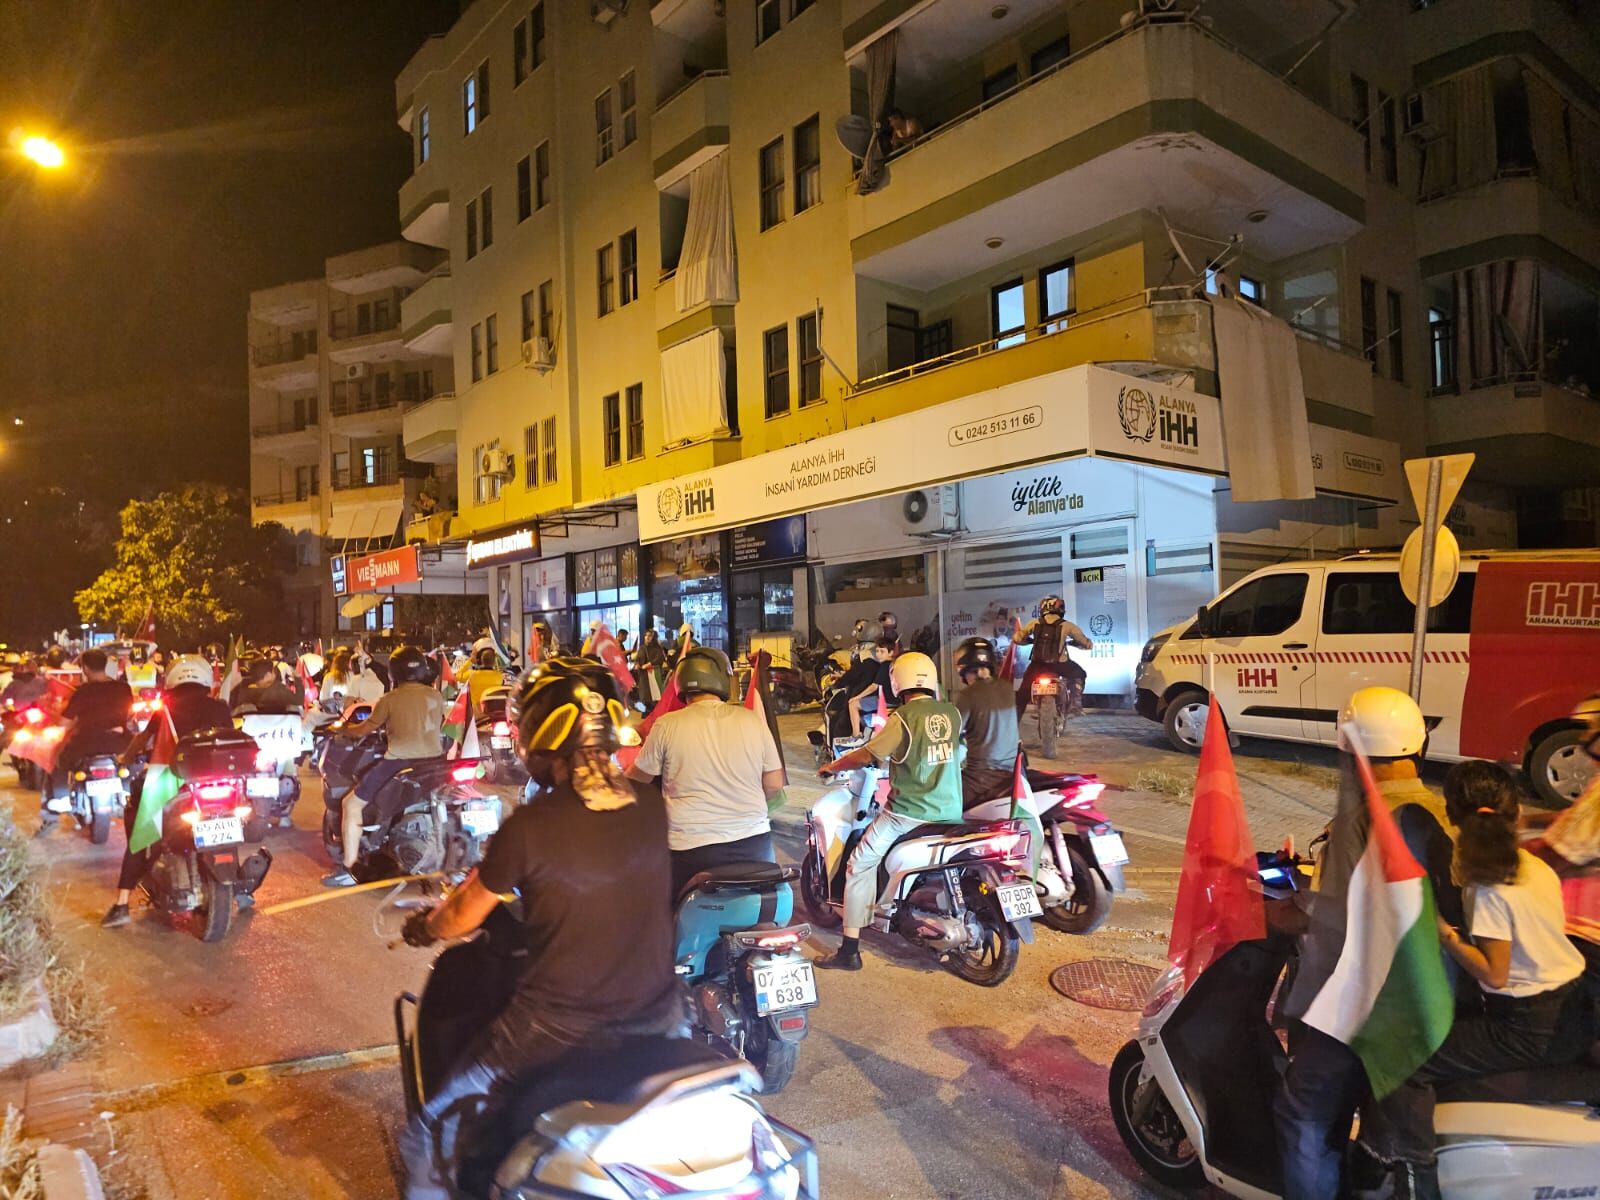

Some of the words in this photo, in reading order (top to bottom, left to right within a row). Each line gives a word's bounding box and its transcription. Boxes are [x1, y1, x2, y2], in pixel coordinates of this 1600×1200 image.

[1159, 395, 1197, 414] ALANYA
[966, 424, 988, 439] 0242
[990, 419, 1007, 433] 513
[1010, 416, 1019, 428] 11
[1022, 413, 1035, 425] 66
[790, 454, 826, 473] ALANYA
[684, 478, 713, 492] ALANYA
[765, 476, 795, 497] İNSANİ
[796, 471, 831, 490] YARDIM
[833, 456, 876, 482] DERNEĞİ
[1011, 475, 1063, 512] iyilik
[1028, 493, 1084, 515] Alanya'da
[1528, 616, 1561, 625] ARAMA
[1000, 891, 1012, 903] 07
[1013, 887, 1034, 902] BDR
[1014, 902, 1033, 915] 392
[758, 971, 774, 988] 07
[776, 986, 804, 1004] 638
